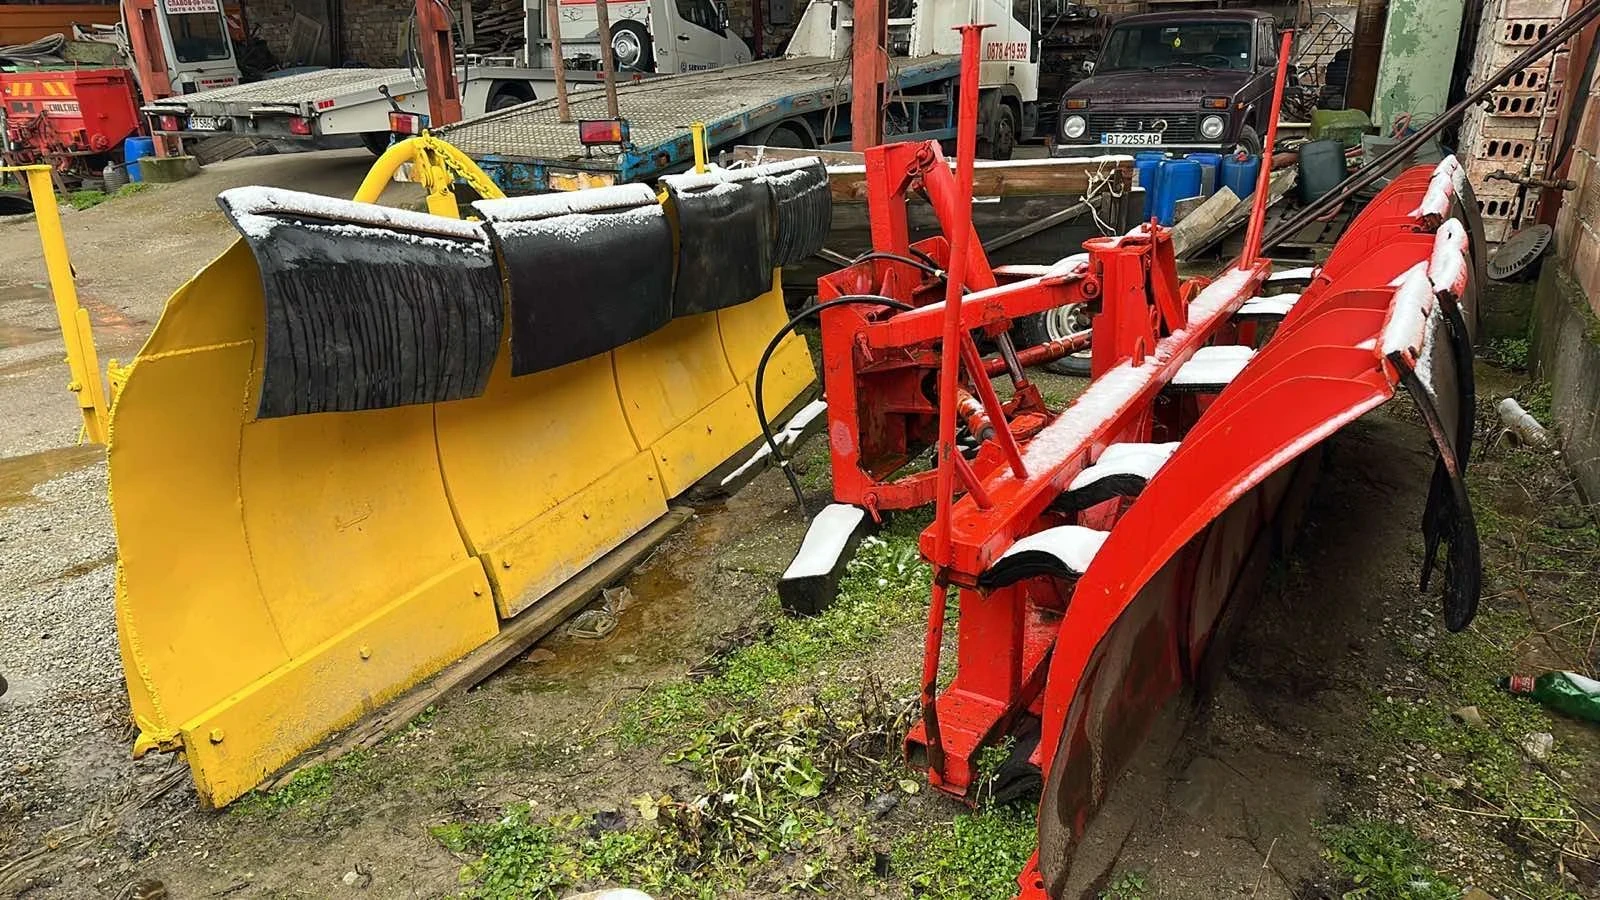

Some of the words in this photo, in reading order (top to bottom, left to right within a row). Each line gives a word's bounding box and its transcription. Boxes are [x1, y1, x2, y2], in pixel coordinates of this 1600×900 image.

[987, 42, 1003, 60] 0878
[1004, 42, 1016, 59] 419
[1016, 42, 1028, 59] 558
[1107, 134, 1121, 145] BT
[1122, 134, 1145, 145] 2255
[1147, 134, 1160, 145] AP
